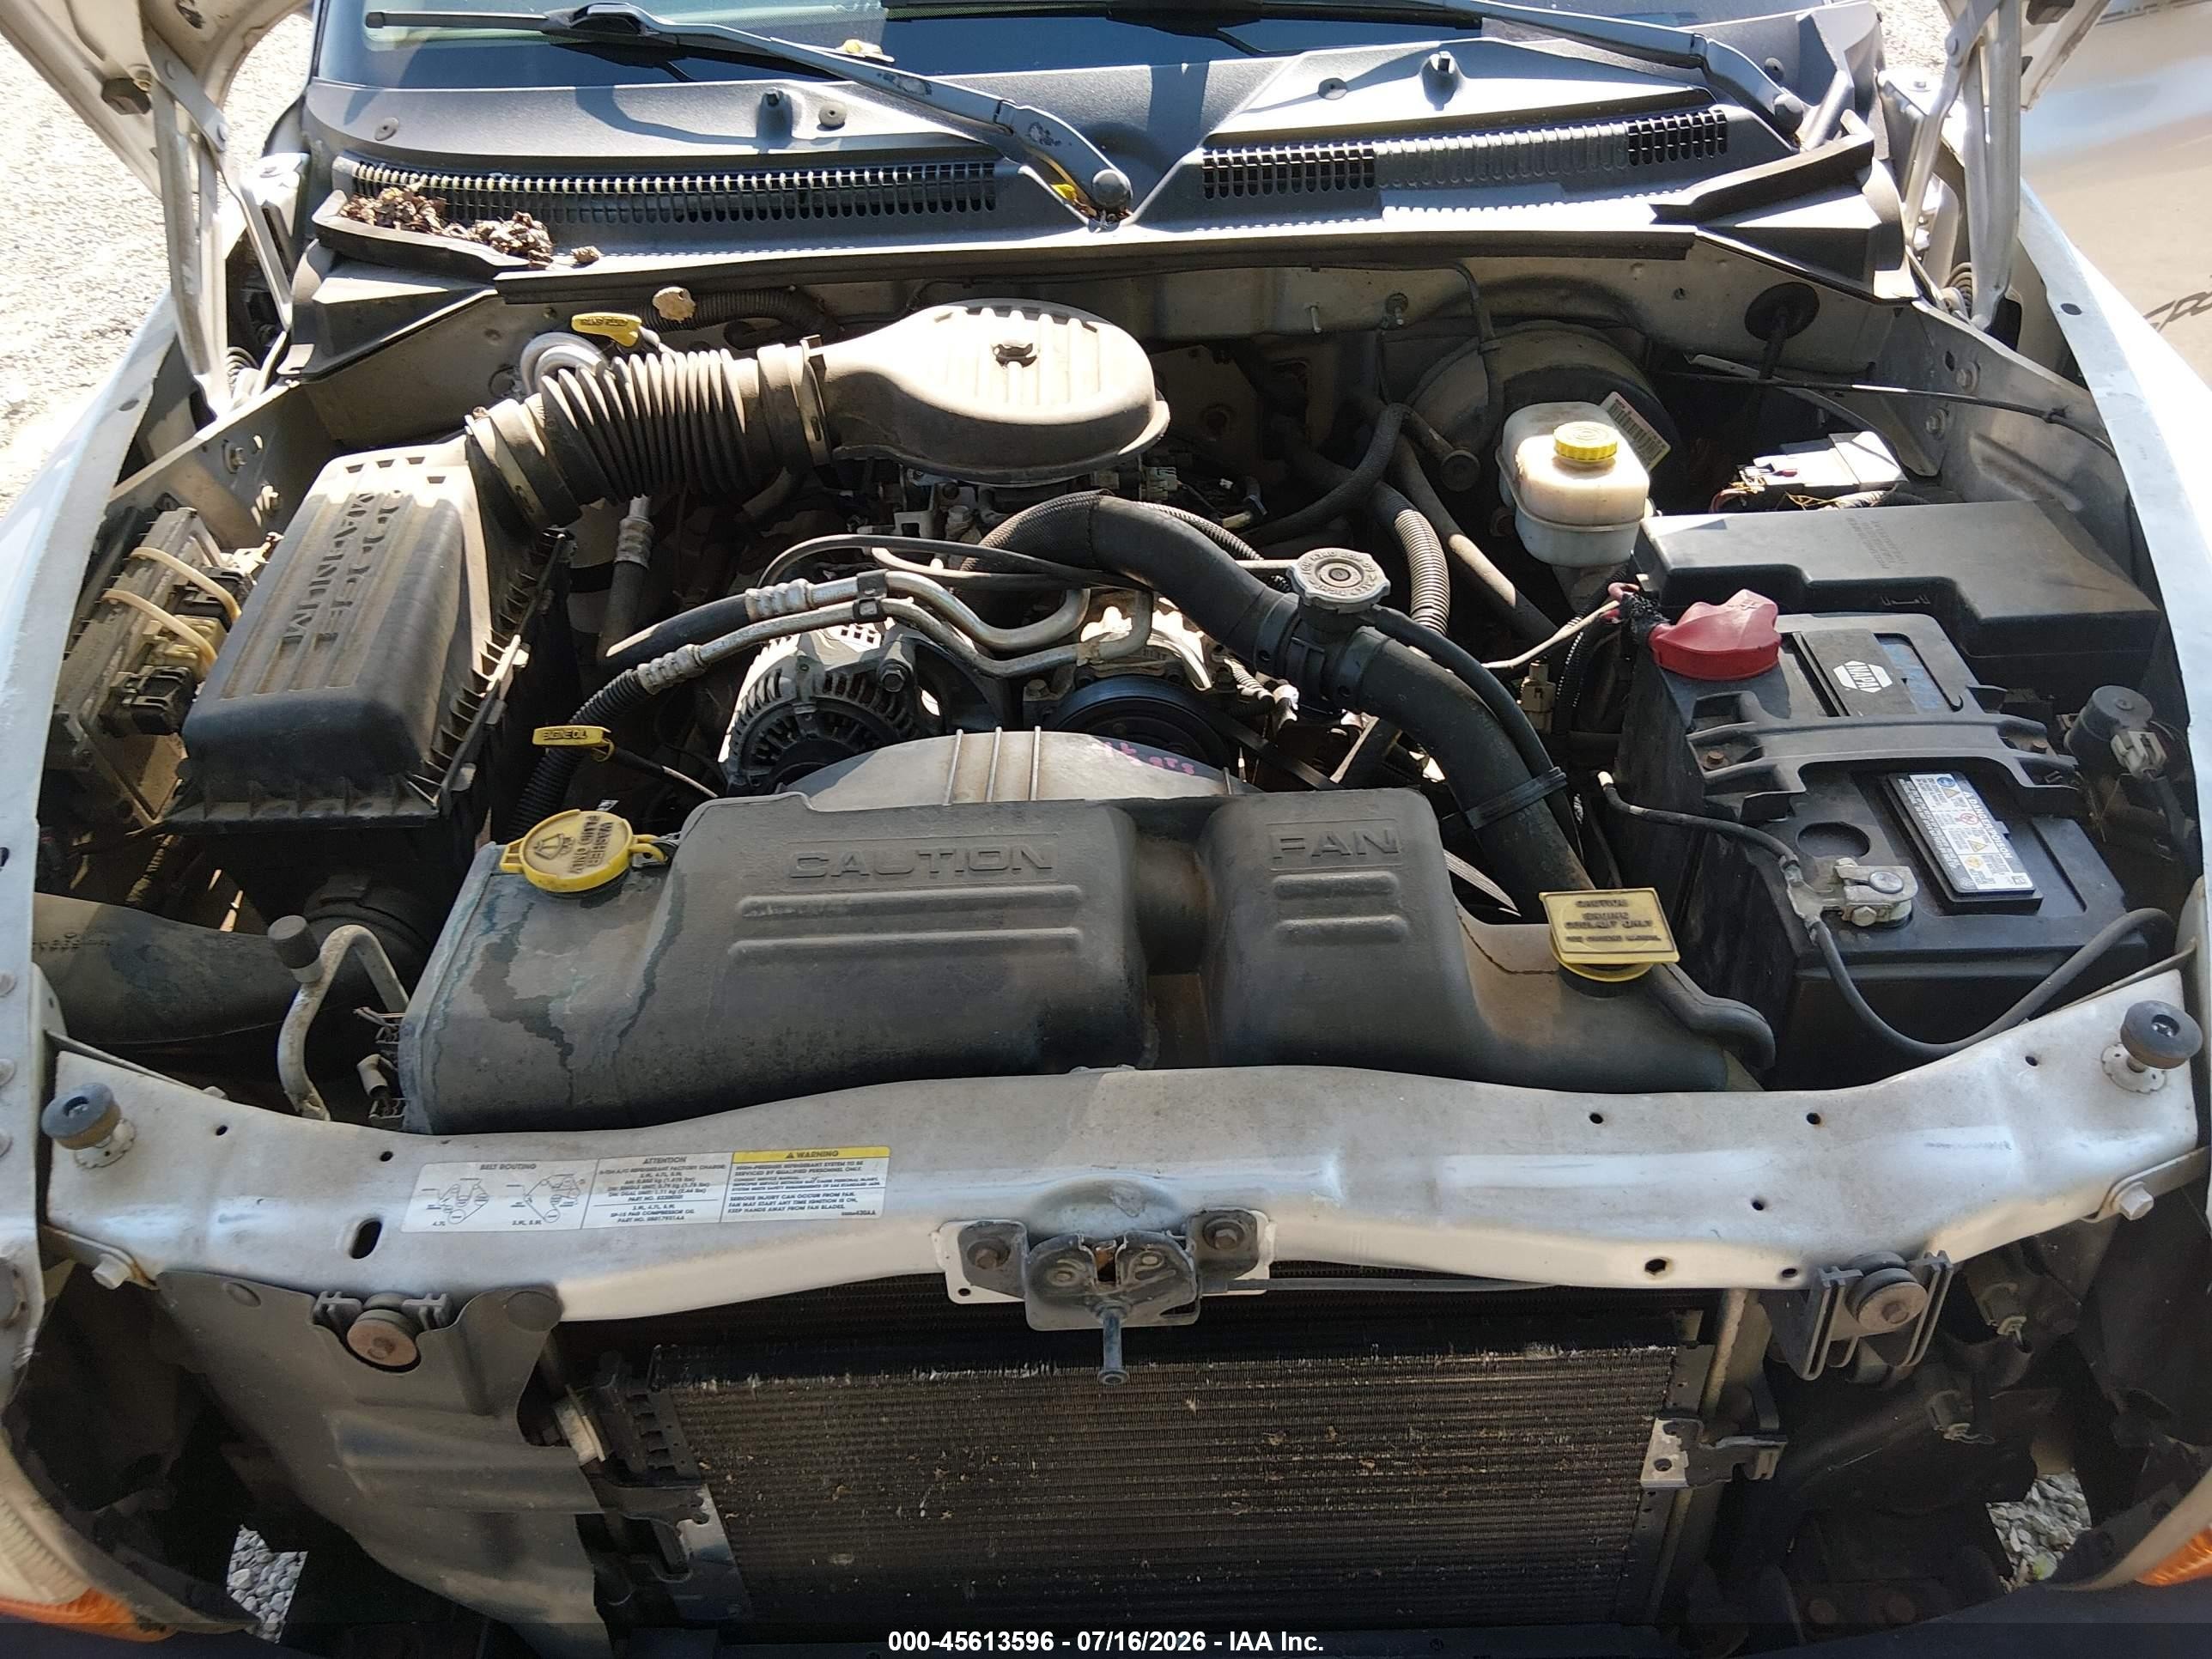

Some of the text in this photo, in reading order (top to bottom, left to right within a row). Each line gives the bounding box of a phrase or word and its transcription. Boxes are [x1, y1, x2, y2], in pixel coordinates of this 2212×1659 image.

[282, 493, 376, 644] MAGNUM
[1846, 664, 1880, 689] NAPA
[568, 815, 599, 875] FLUID ONLY
[586, 821, 614, 868] WASHER
[787, 844, 1054, 880] CAUTION
[1269, 828, 1401, 860] FAN
